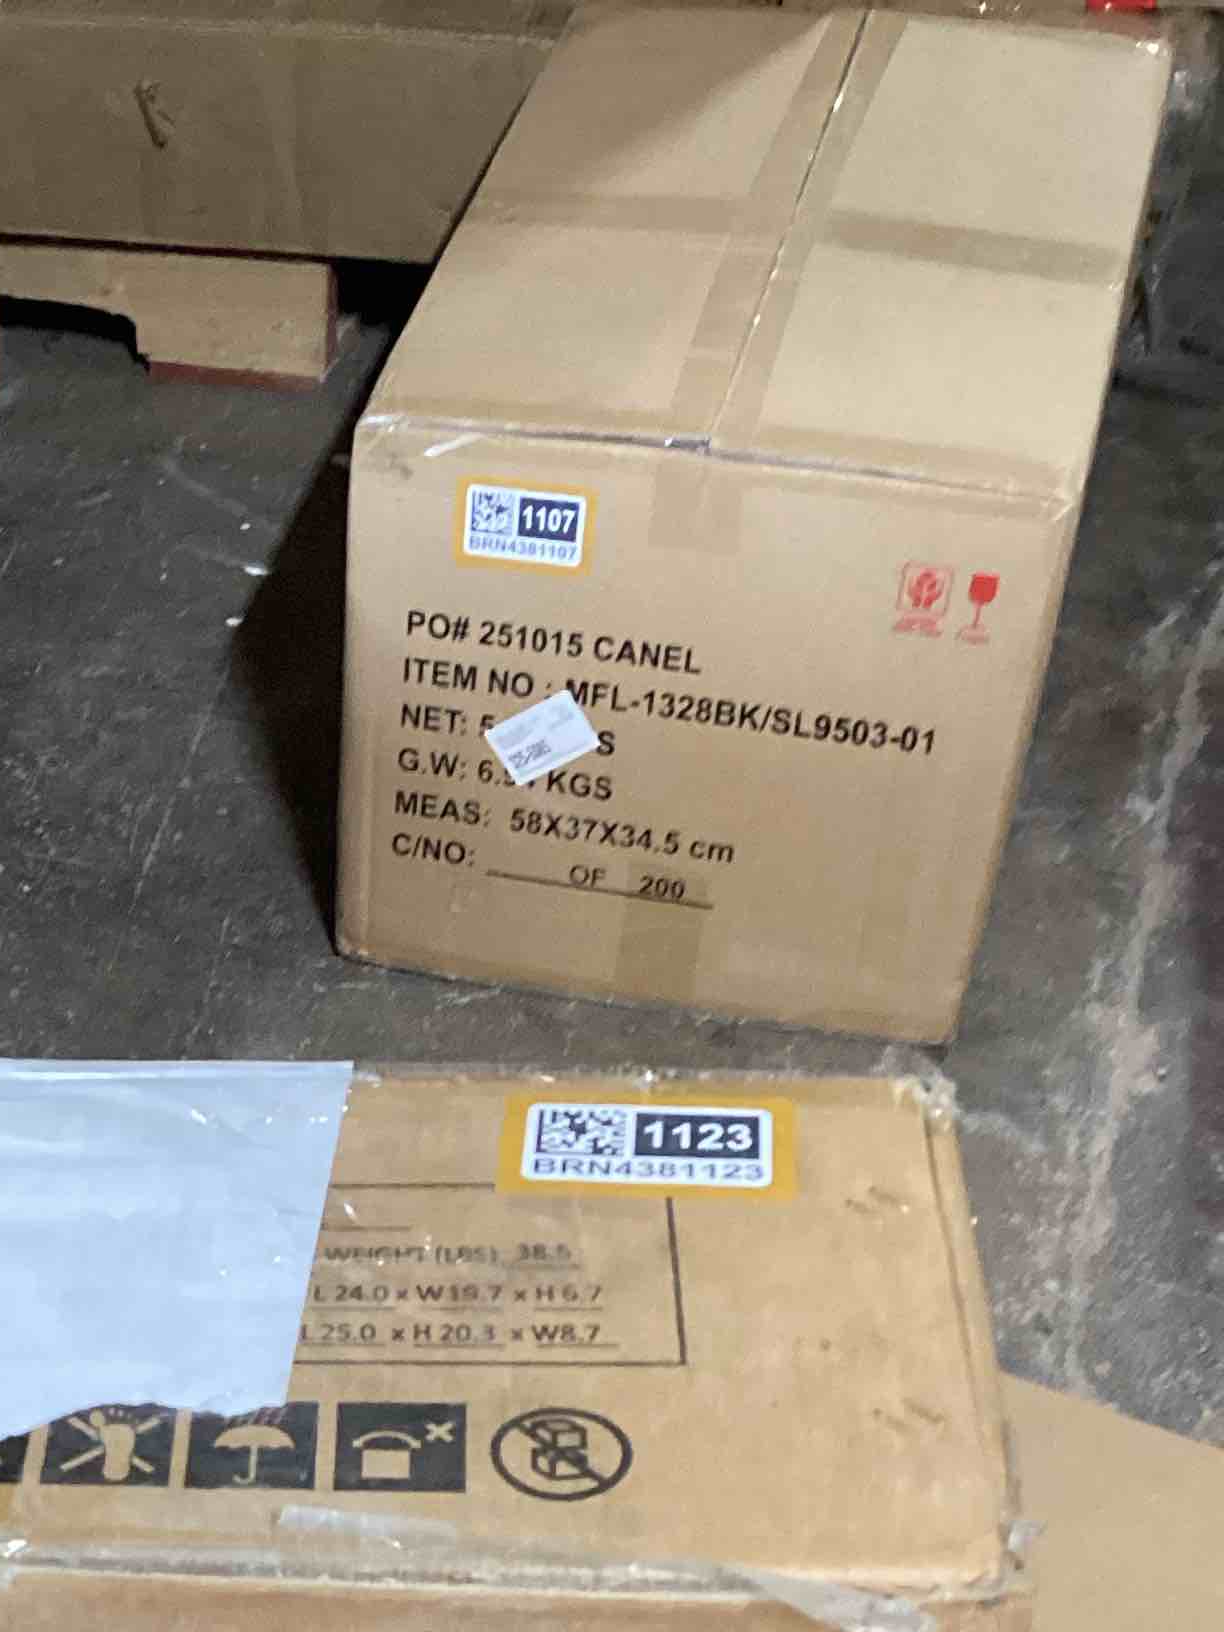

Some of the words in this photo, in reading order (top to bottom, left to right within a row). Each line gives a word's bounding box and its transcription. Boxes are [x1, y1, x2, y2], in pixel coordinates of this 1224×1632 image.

[522, 505, 575, 534] 1107
[407, 610, 469, 640] PO#
[479, 621, 583, 657] 251015
[594, 636, 701, 675] CANEL
[400, 703, 467, 736] NET:
[403, 657, 476, 692] ITEM
[566, 679, 936, 755] MFL-1328BK/SL9503-01
[398, 748, 466, 779] G.W:
[546, 769, 613, 800] KGS
[394, 790, 490, 827] MEAS:
[510, 808, 680, 855] 58X37X34.5
[689, 839, 735, 863] cm
[391, 833, 475, 866] C/NO:
[569, 865, 606, 887] OF
[639, 875, 686, 900] 200
[643, 1120, 753, 1151] 1123
[533, 1158, 764, 1182] BRN4381123
